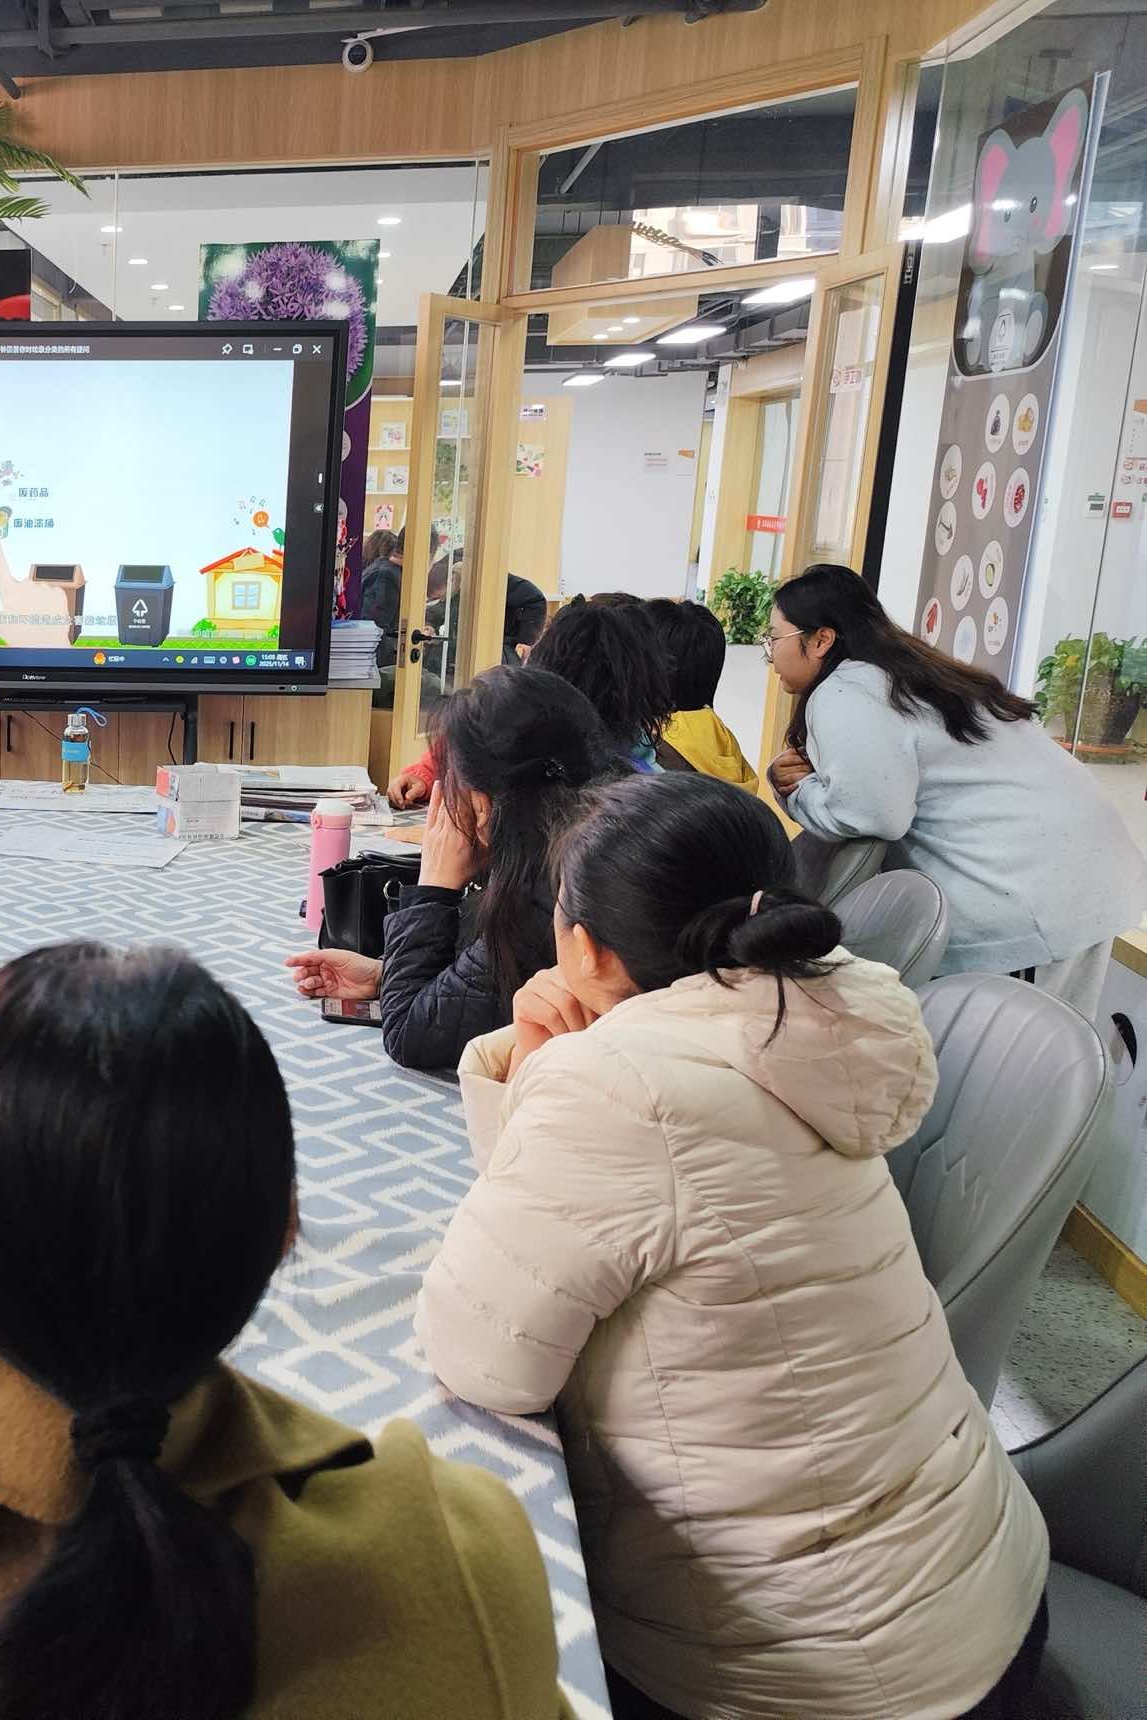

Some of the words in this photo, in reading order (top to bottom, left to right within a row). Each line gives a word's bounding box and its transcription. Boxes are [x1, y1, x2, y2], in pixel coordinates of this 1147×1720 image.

[18, 487, 49, 498] 废药品
[13, 518, 55, 529] 废油漆桶
